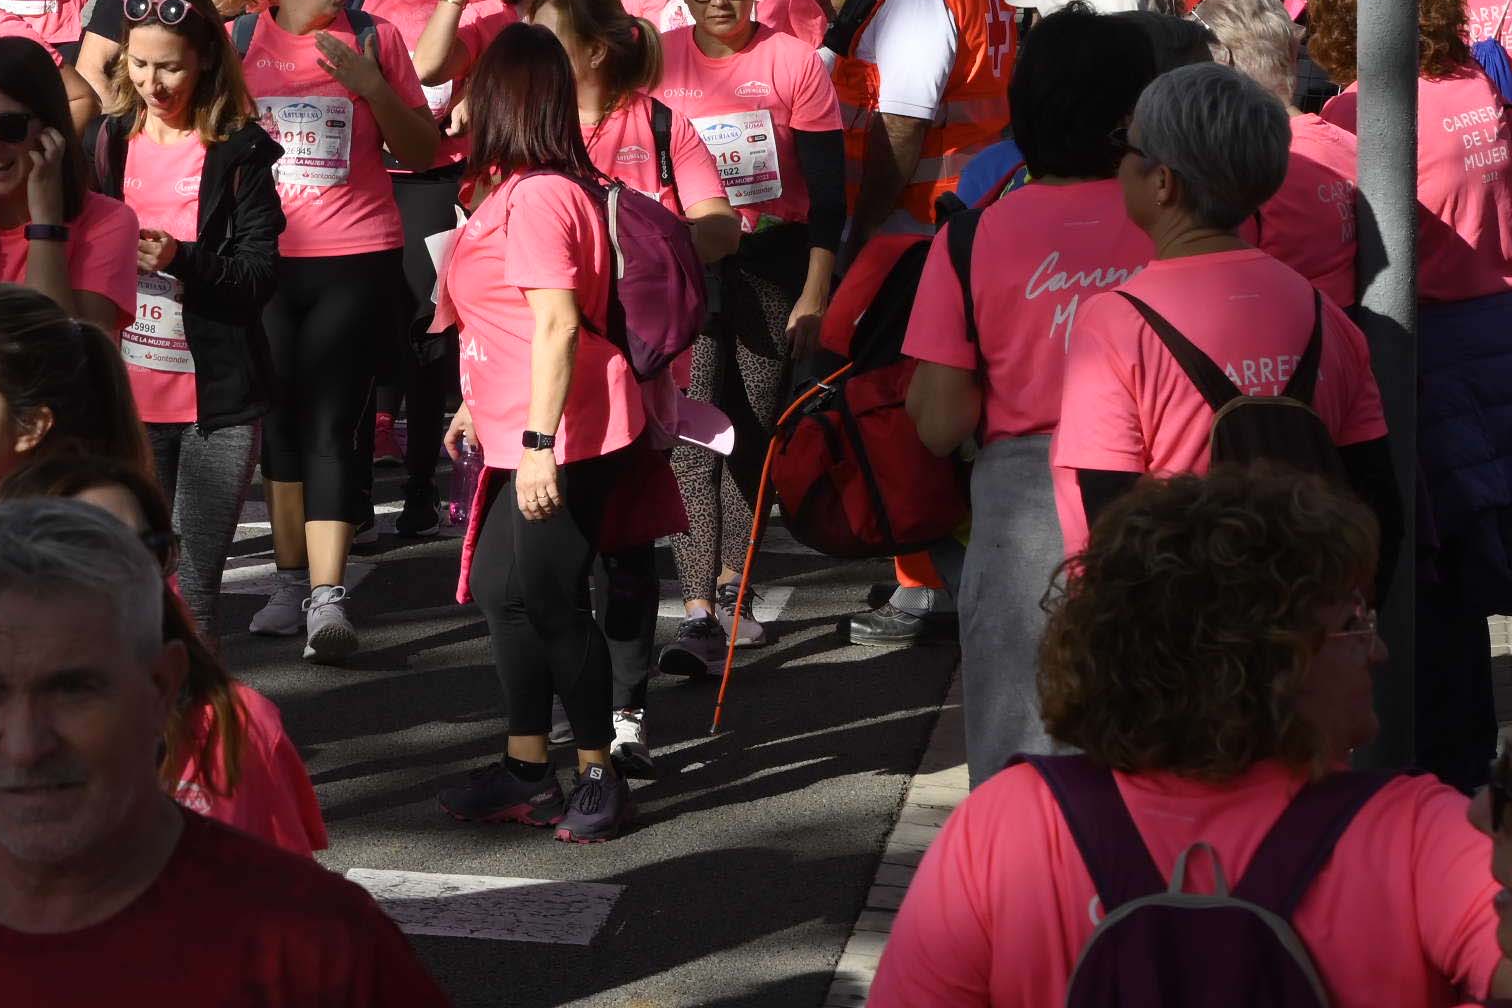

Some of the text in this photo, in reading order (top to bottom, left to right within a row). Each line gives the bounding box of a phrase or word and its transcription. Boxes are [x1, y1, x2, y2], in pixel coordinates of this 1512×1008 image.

[663, 88, 703, 98] OYSHO
[284, 131, 317, 143] 016
[1463, 131, 1481, 149] DE
[1464, 146, 1509, 172] MUJER
[148, 338, 170, 346] MUJER
[153, 353, 189, 364] Santander
